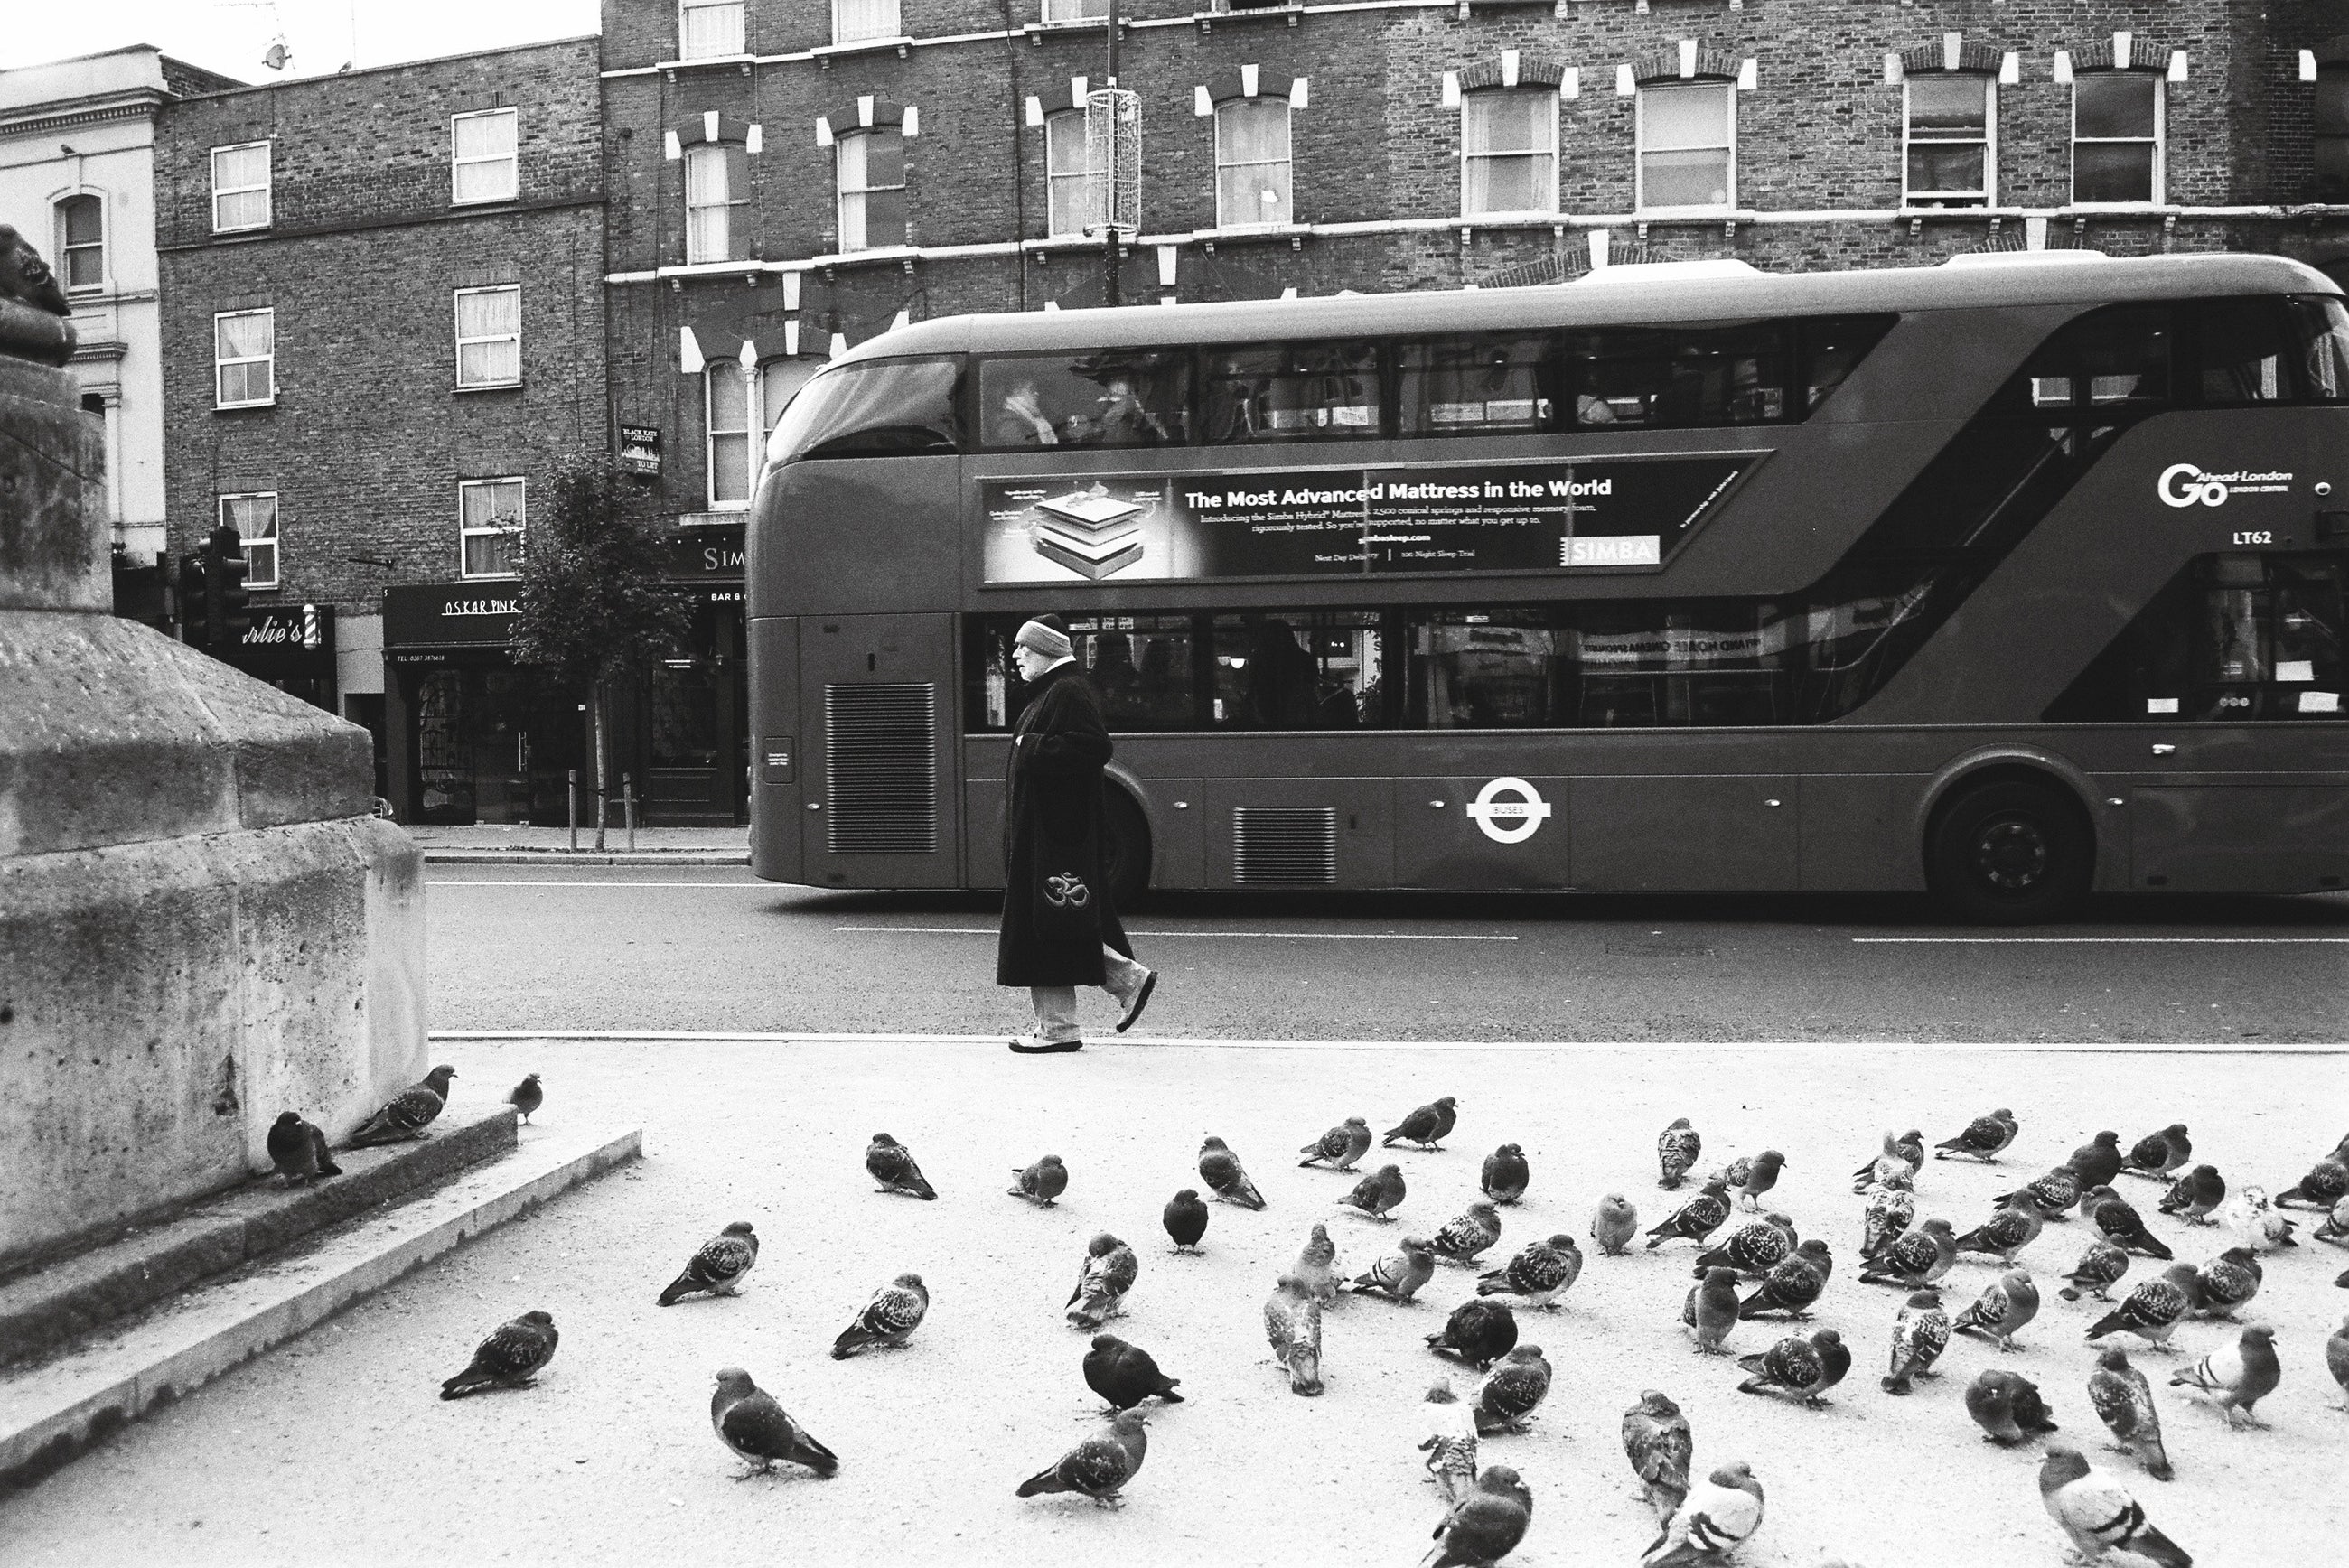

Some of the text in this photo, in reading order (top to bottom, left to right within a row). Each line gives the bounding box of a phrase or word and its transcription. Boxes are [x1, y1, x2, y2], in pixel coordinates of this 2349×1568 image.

[646, 461, 658, 470] LET
[1185, 477, 1612, 509] The Most Advanced Mattress in the World
[2157, 462, 2228, 508] Go
[1201, 513, 1250, 523] Introducing
[1251, 512, 1266, 521] the
[1267, 511, 1294, 520] Simba
[1430, 506, 1464, 516] springs
[1465, 505, 1482, 513] and
[1483, 505, 1531, 515] responsive
[1252, 522, 1295, 534] rigorously
[1325, 521, 1338, 530] So
[1458, 516, 1480, 524] what
[1481, 518, 1499, 527] you
[1499, 518, 1514, 526] get
[2233, 531, 2272, 545] LT62
[1415, 550, 1436, 559] Night
[1573, 541, 1652, 561] SIMBA
[711, 593, 731, 601] BAR
[445, 599, 519, 614] OSKAR PINK
[241, 615, 303, 644] rlie's
[1493, 805, 1524, 815] BUSES
